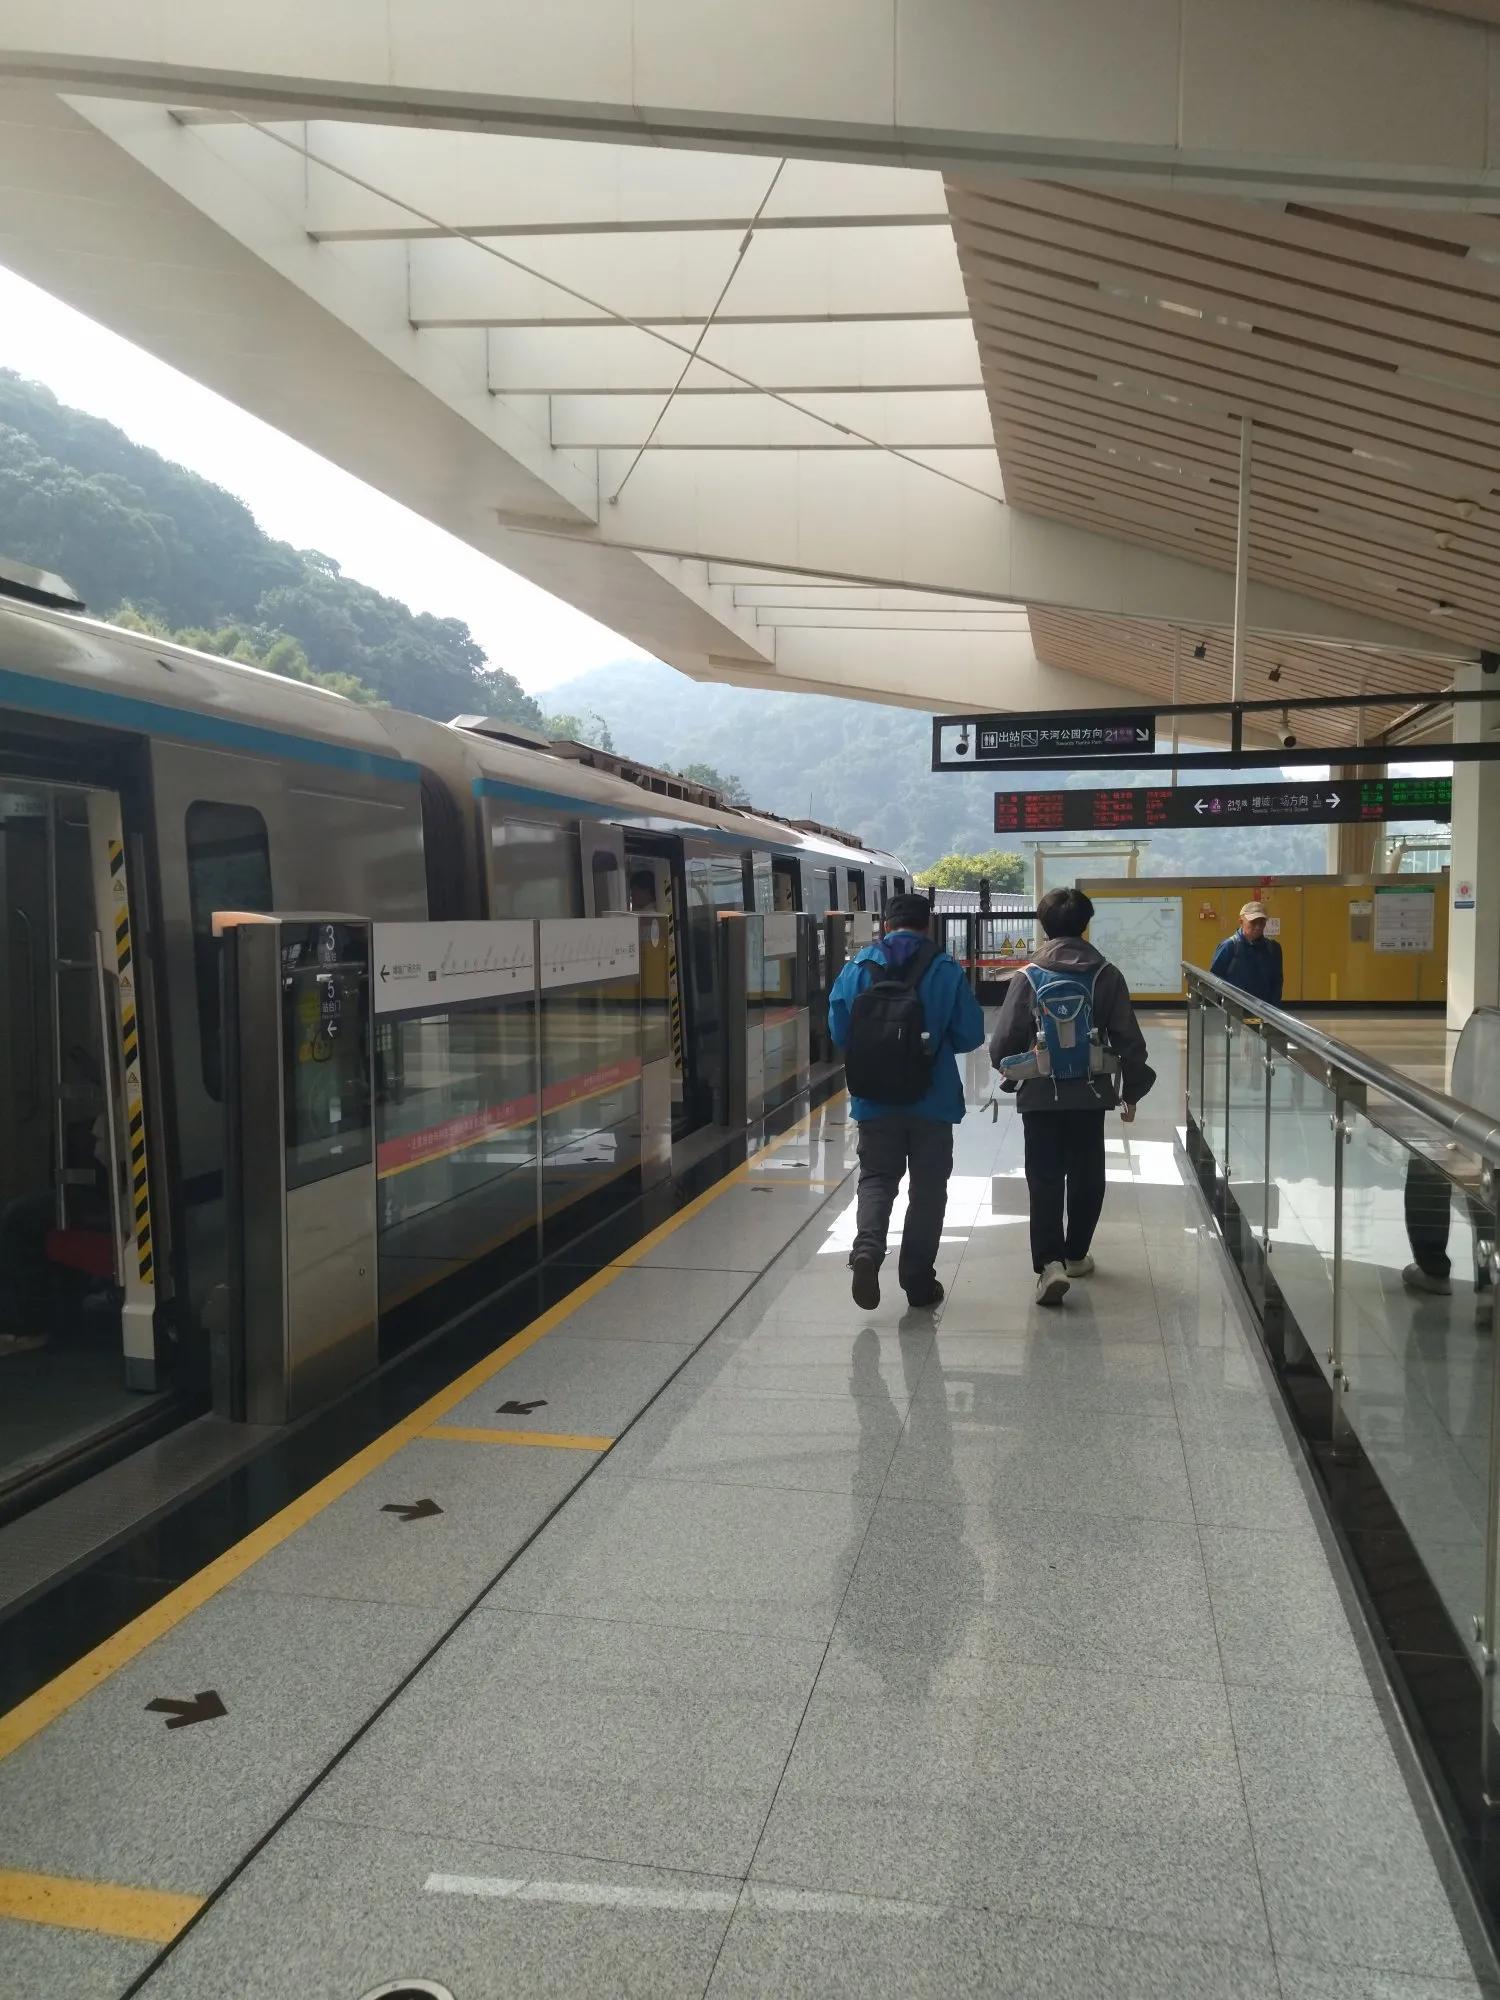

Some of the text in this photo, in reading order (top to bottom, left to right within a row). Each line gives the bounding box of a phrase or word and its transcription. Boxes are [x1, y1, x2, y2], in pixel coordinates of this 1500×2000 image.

[998, 730, 1020, 743] 出站
[1039, 728, 1102, 740] 天河公园方向
[326, 925, 335, 951] 3
[327, 980, 335, 999] 5
